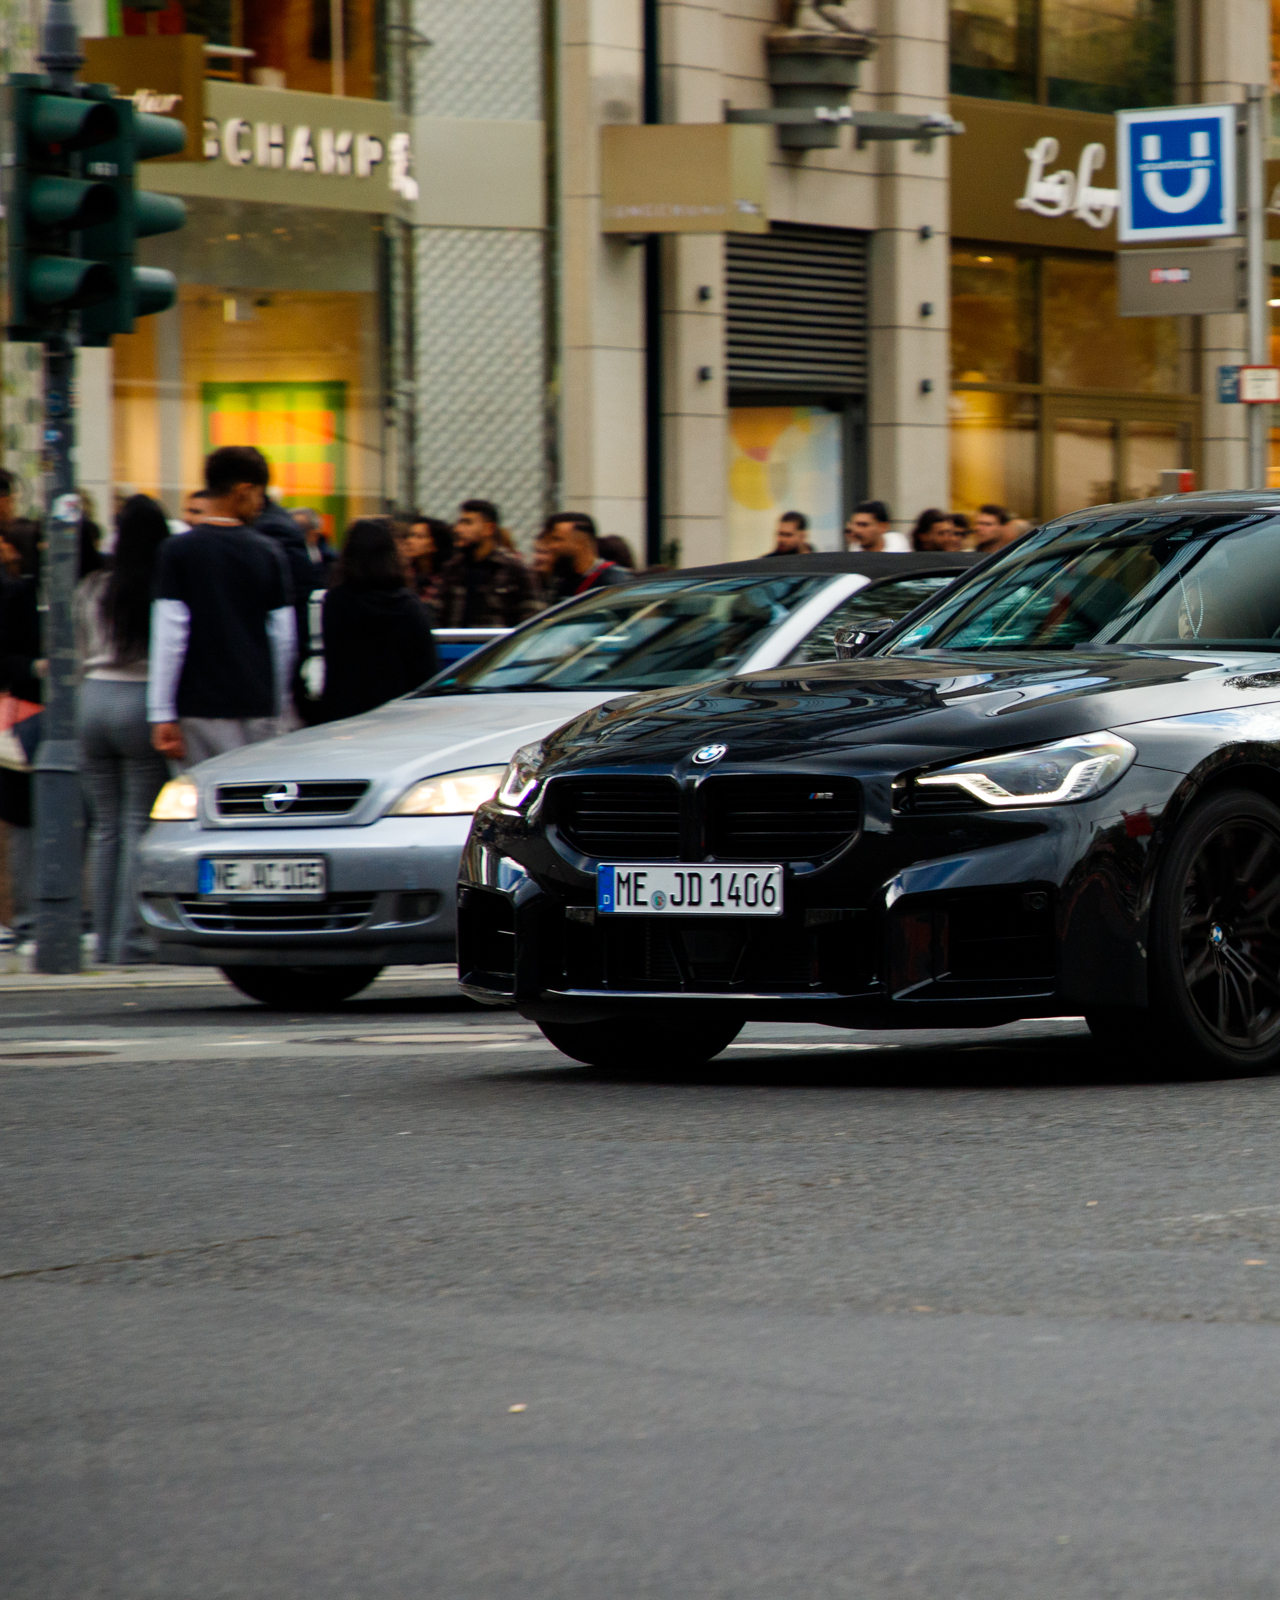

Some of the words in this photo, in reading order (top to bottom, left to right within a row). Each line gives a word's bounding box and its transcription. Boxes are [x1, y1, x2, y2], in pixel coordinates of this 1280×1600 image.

[616, 872, 648, 906] ME
[669, 872, 702, 907] JD
[709, 872, 776, 907] 1406
